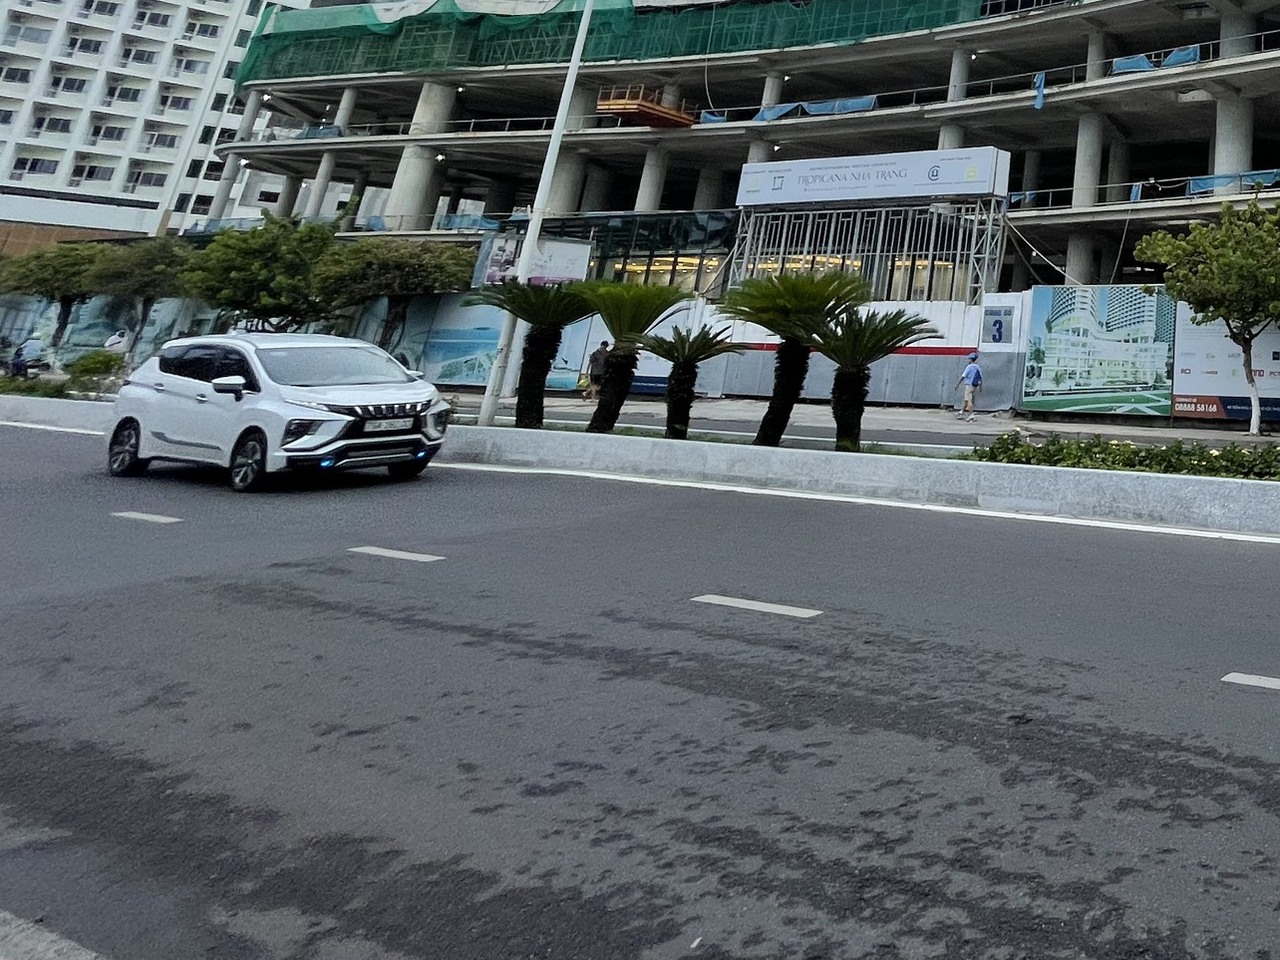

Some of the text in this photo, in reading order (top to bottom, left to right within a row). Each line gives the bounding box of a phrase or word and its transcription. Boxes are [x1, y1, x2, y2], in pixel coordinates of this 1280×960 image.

[797, 168, 908, 186] TROPICANA NHA TRANG
[992, 319, 1003, 344] 3
